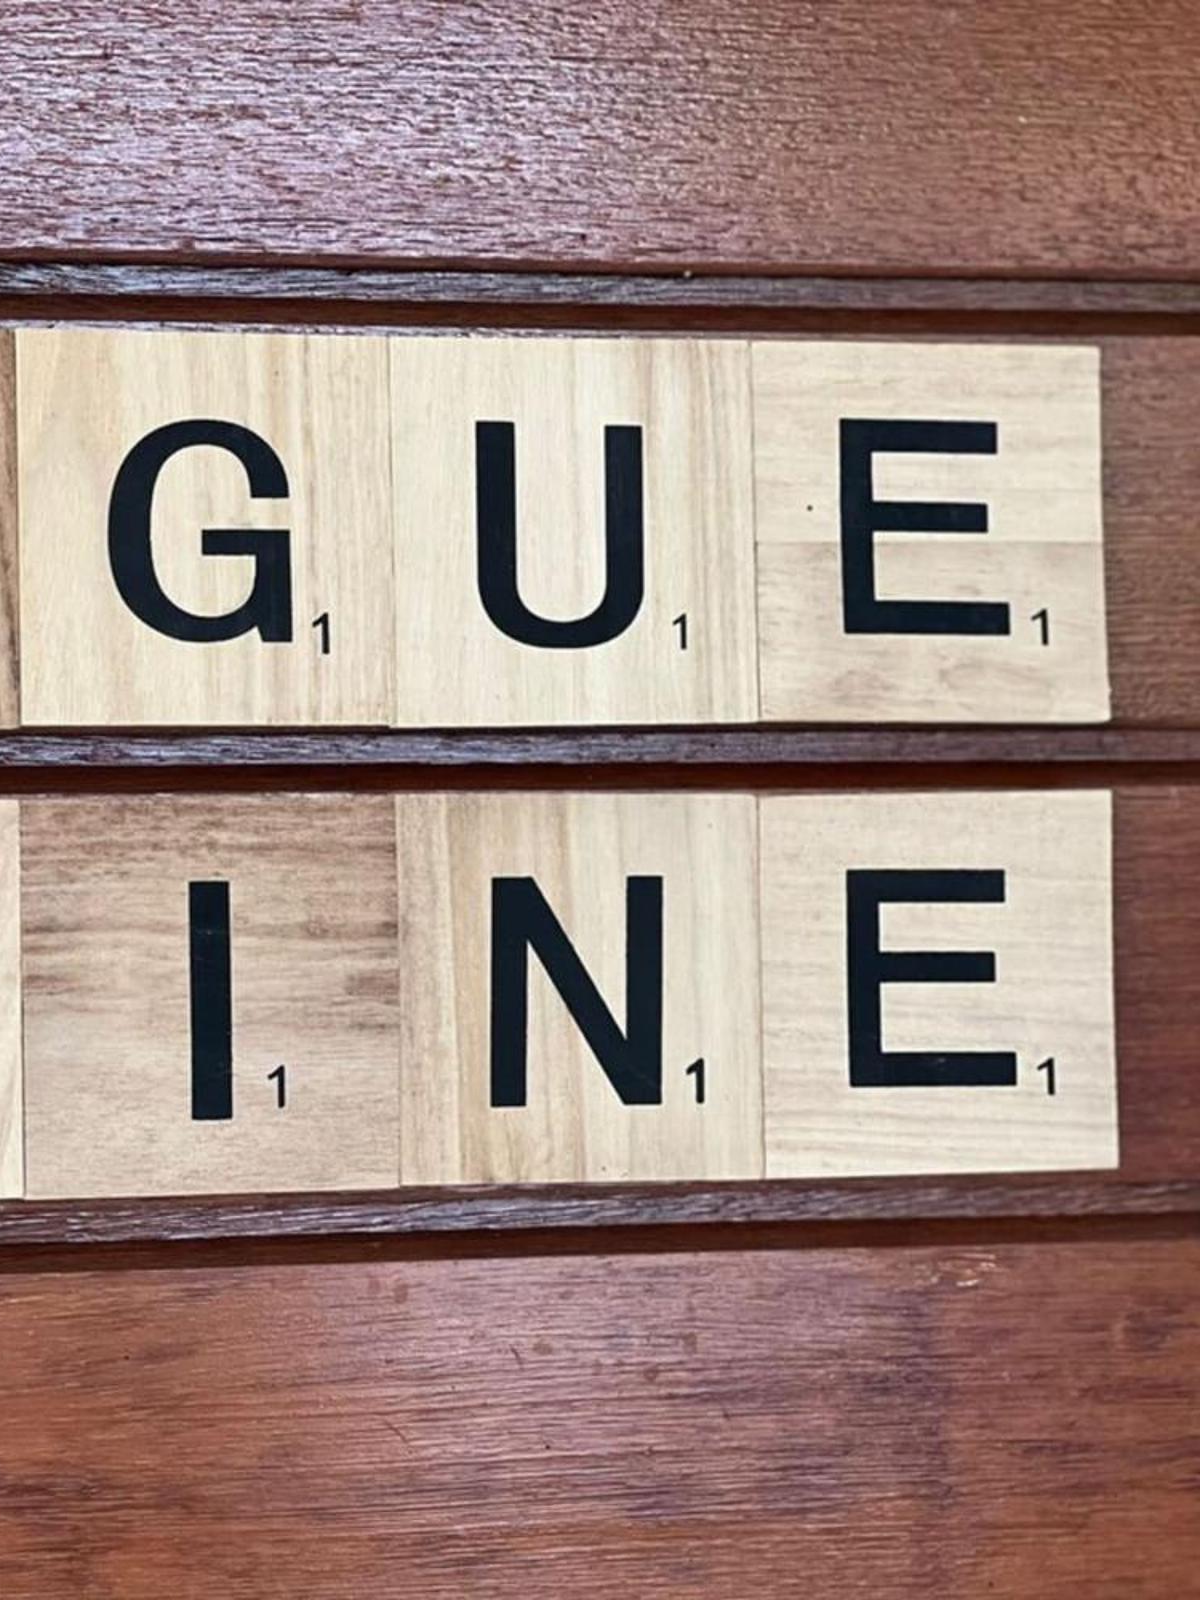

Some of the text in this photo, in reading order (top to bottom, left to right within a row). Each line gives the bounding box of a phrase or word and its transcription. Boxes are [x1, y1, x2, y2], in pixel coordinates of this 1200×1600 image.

[311, 612, 331, 655] 1
[672, 613, 688, 650] 1
[1031, 608, 1049, 646] 1
[267, 1064, 286, 1109] 1
[685, 1057, 705, 1105] 1
[1036, 1057, 1056, 1096] 1
